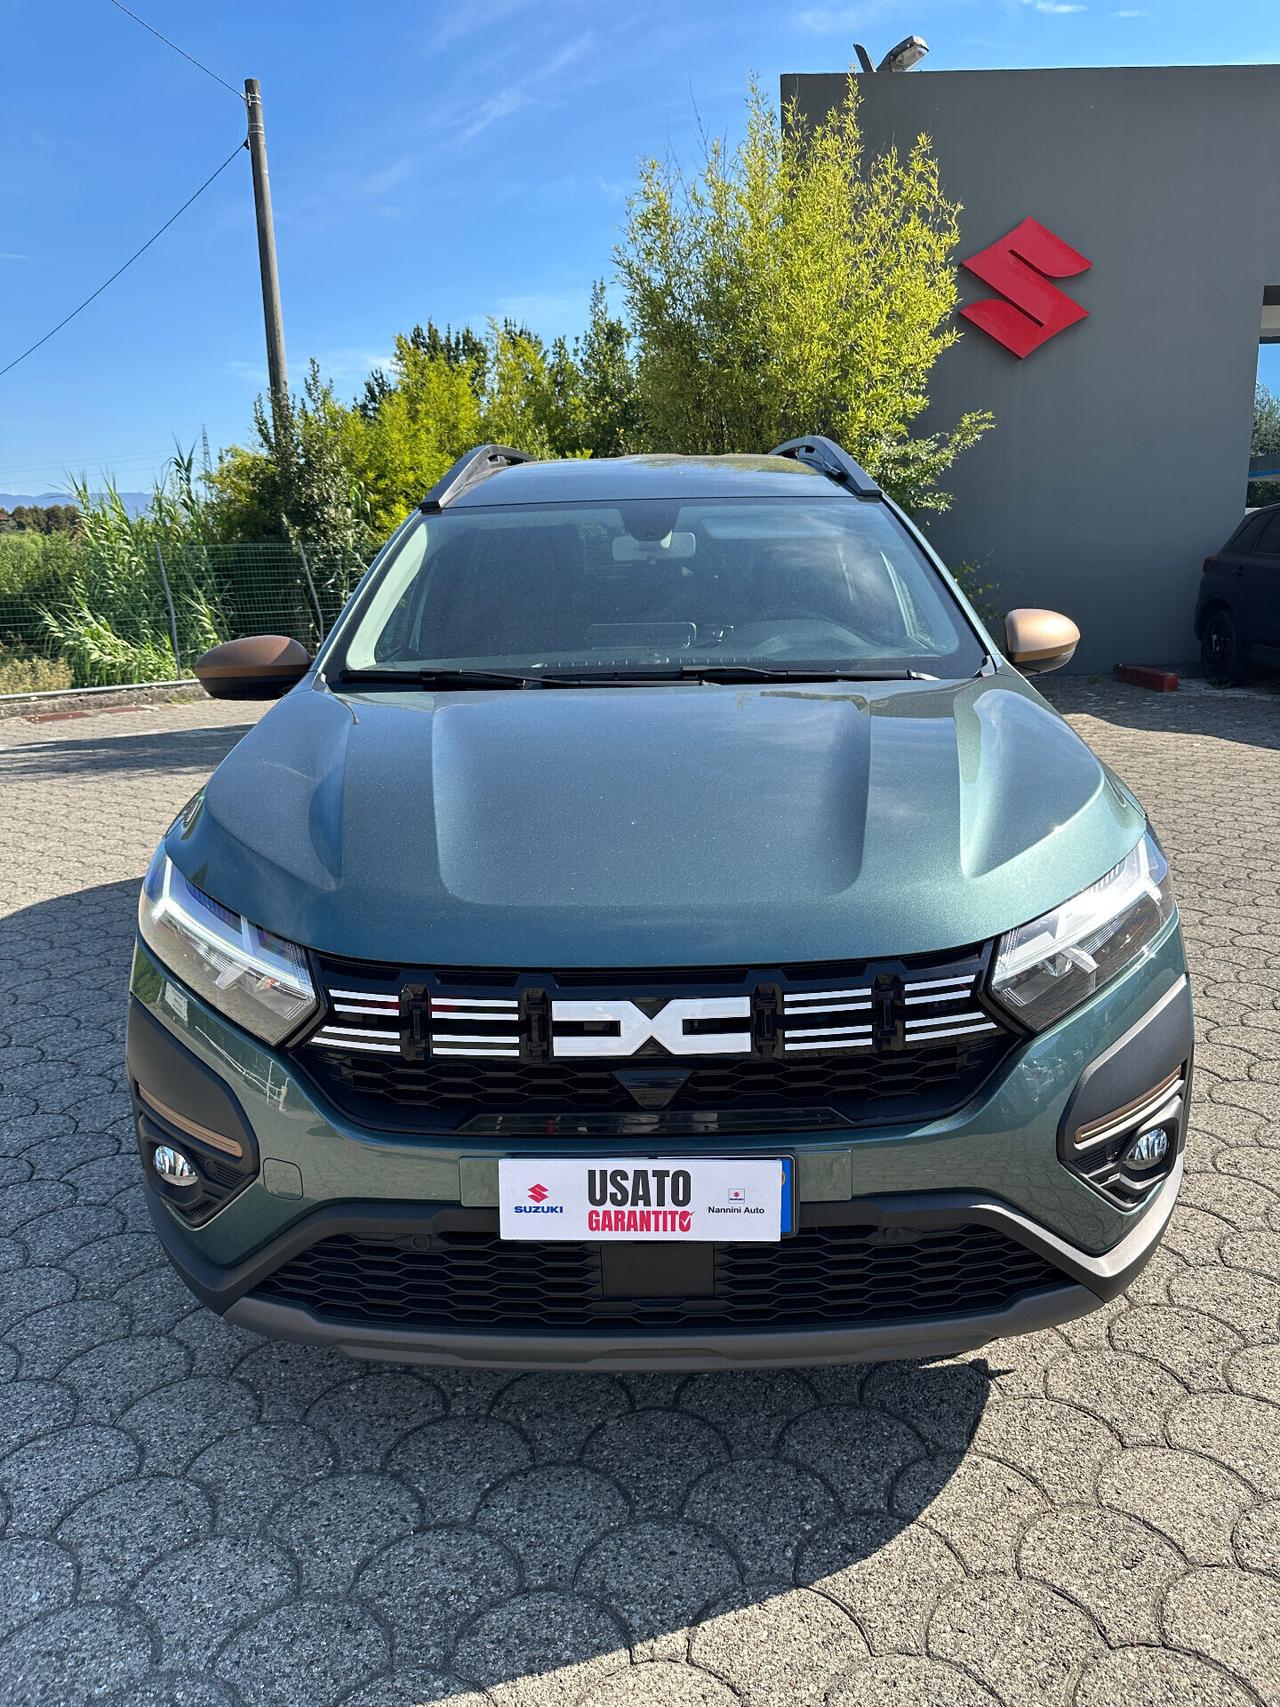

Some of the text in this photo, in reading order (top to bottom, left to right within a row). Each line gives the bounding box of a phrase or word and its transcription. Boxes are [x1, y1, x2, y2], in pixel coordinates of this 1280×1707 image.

[587, 1169, 692, 1207] USATO
[514, 1205, 564, 1214] SUZUKI
[708, 1206, 765, 1214] Nannini Auto
[587, 1208, 694, 1233] GARANTITO
